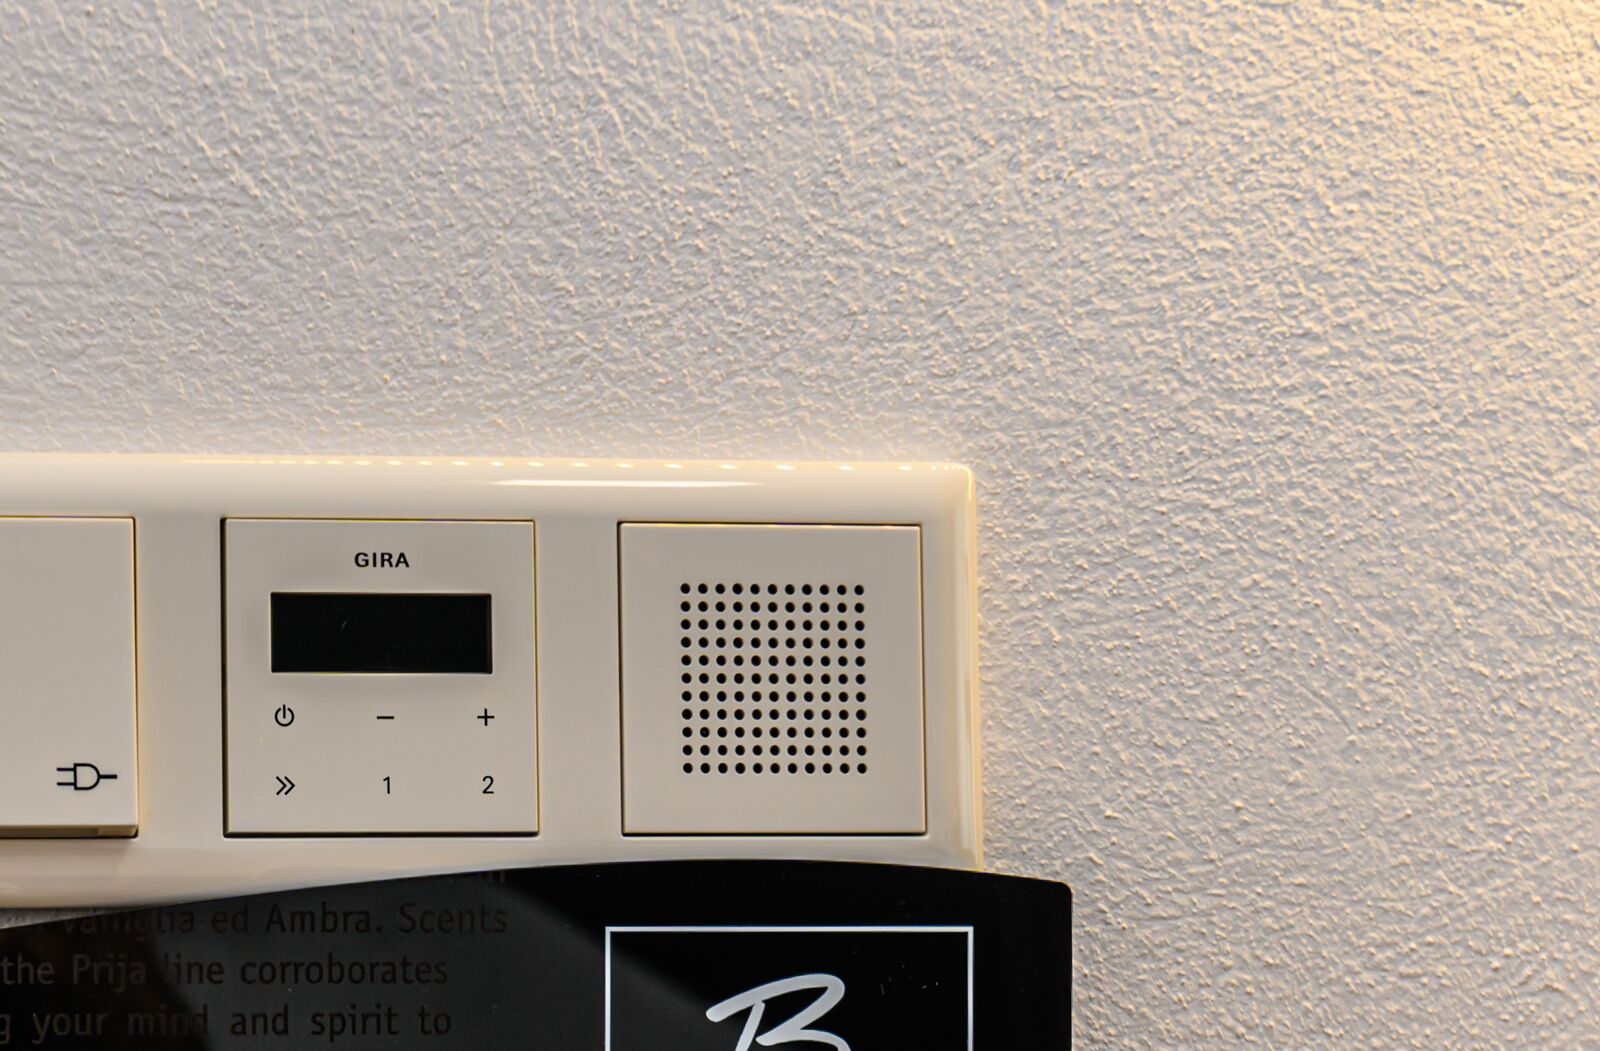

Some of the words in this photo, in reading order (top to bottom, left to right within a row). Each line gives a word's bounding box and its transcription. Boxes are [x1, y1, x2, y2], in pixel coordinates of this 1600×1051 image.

[353, 551, 410, 568] GIRA
[382, 776, 391, 795] 1
[482, 775, 495, 794] 2
[210, 903, 249, 934] ed
[265, 903, 383, 934] Ambra.
[399, 903, 508, 934] Scents
[0, 953, 55, 985] the
[72, 953, 146, 993] Prija
[239, 951, 449, 985] corroborates
[31, 1011, 108, 1045] your
[128, 1004, 208, 1036] mind
[230, 1004, 290, 1036] and
[309, 1003, 398, 1044] spirit
[417, 1007, 452, 1036] to
